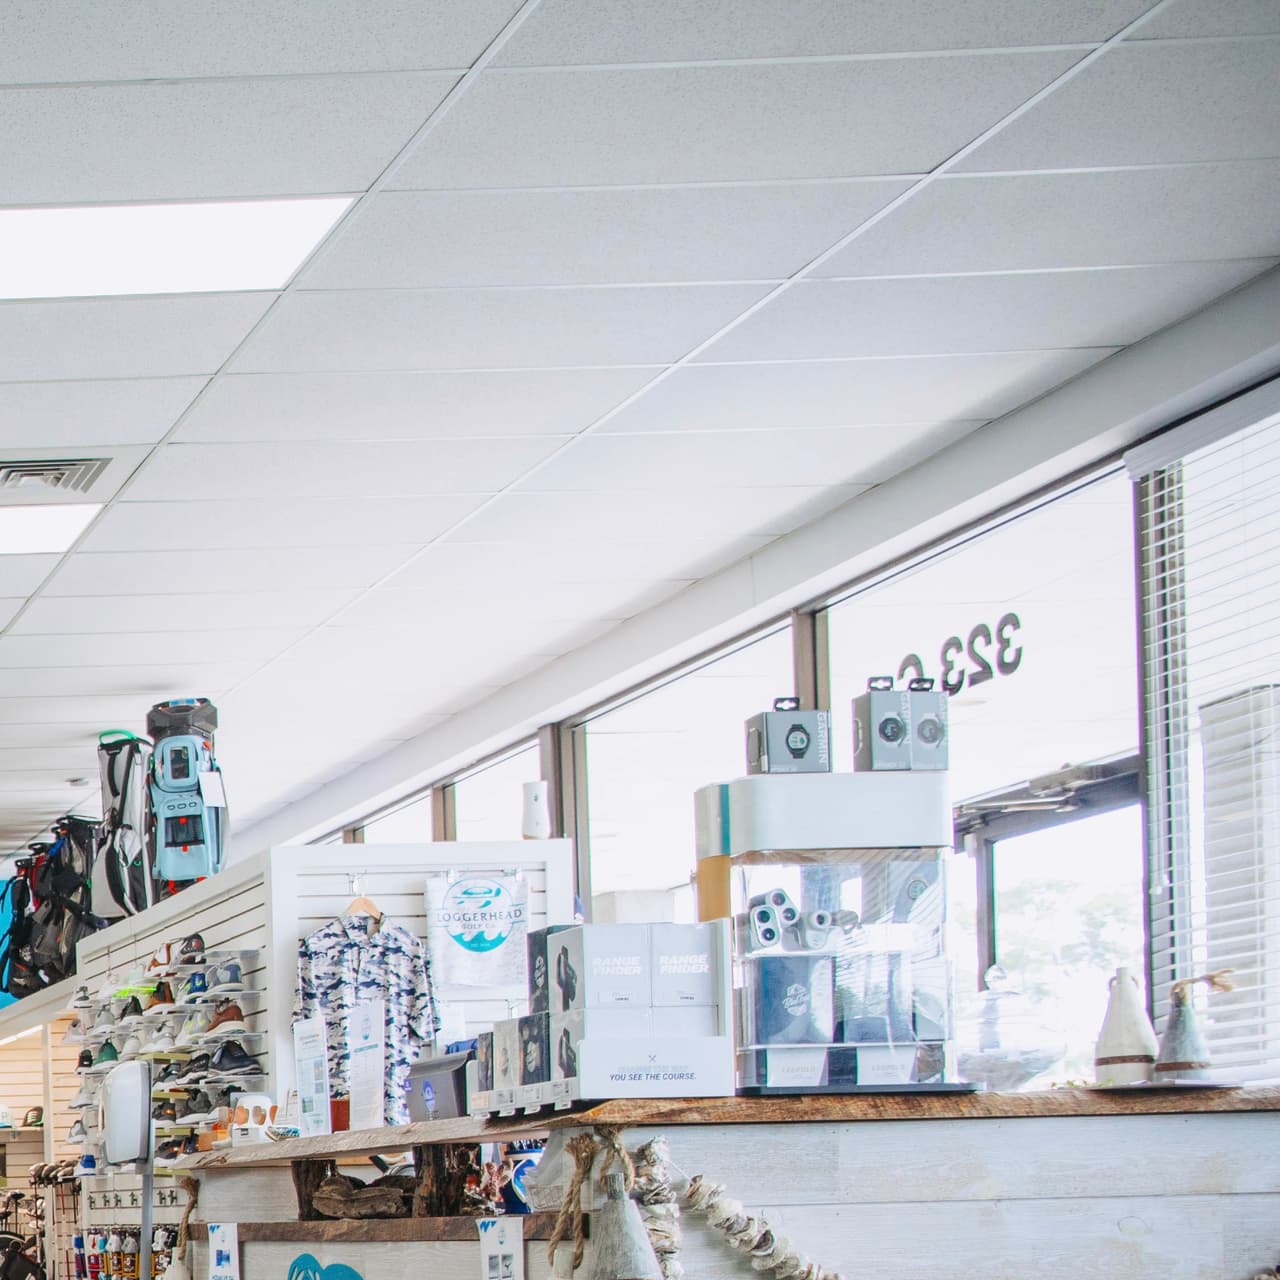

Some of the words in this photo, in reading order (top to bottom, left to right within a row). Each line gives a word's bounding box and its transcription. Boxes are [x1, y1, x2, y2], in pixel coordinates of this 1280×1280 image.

[816, 711, 828, 765] GARMIN
[436, 908, 523, 923] LOGGERHEAD
[659, 953, 709, 965] RANGE
[660, 963, 710, 974] FINDER
[609, 1073, 626, 1082] YOU
[628, 1072, 643, 1081] SEE
[645, 1072, 661, 1081] THE
[662, 1072, 697, 1081] COURSE.
